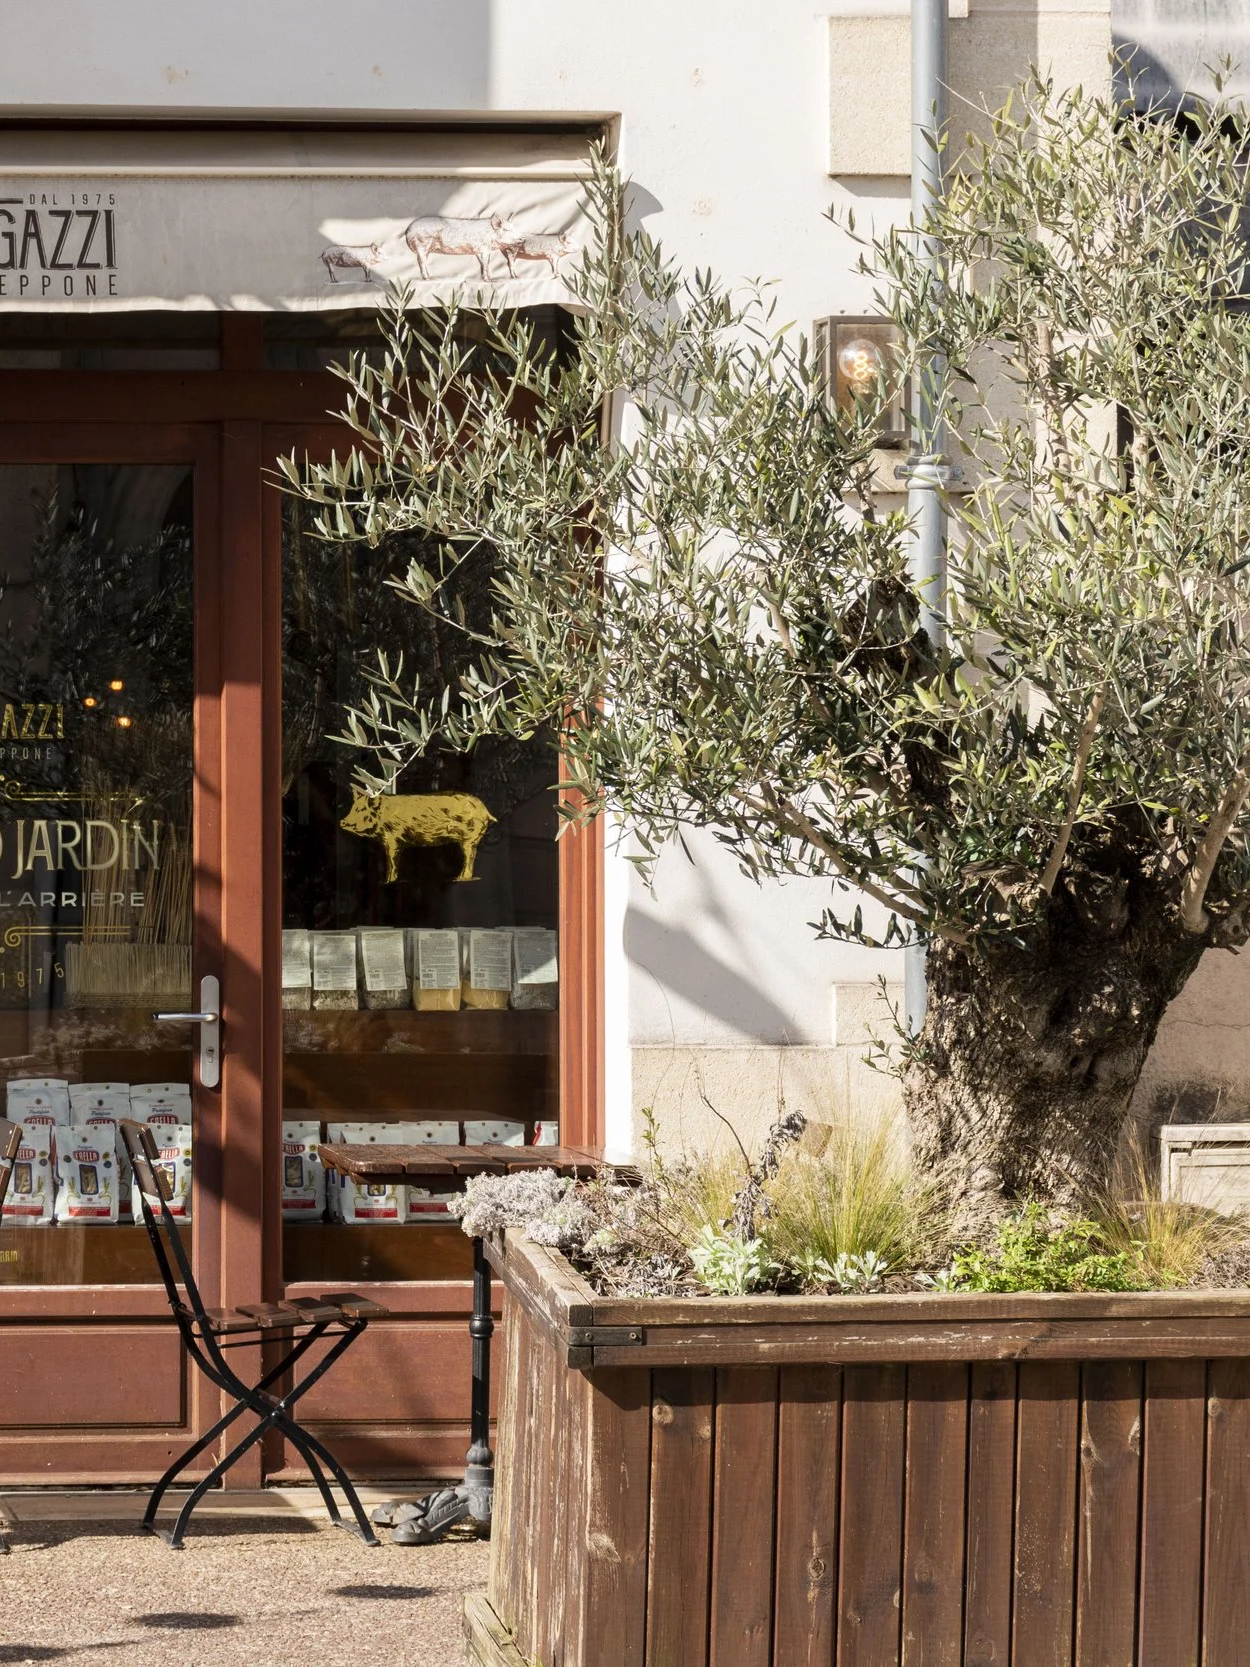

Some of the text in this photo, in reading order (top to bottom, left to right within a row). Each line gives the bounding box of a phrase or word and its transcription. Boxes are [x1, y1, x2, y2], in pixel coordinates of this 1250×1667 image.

[29, 193, 116, 205] DAL 1975
[11, 818, 160, 880] JARDIN
[0, 962, 65, 989] 1975
[74, 1151, 98, 1162] FAELLA
